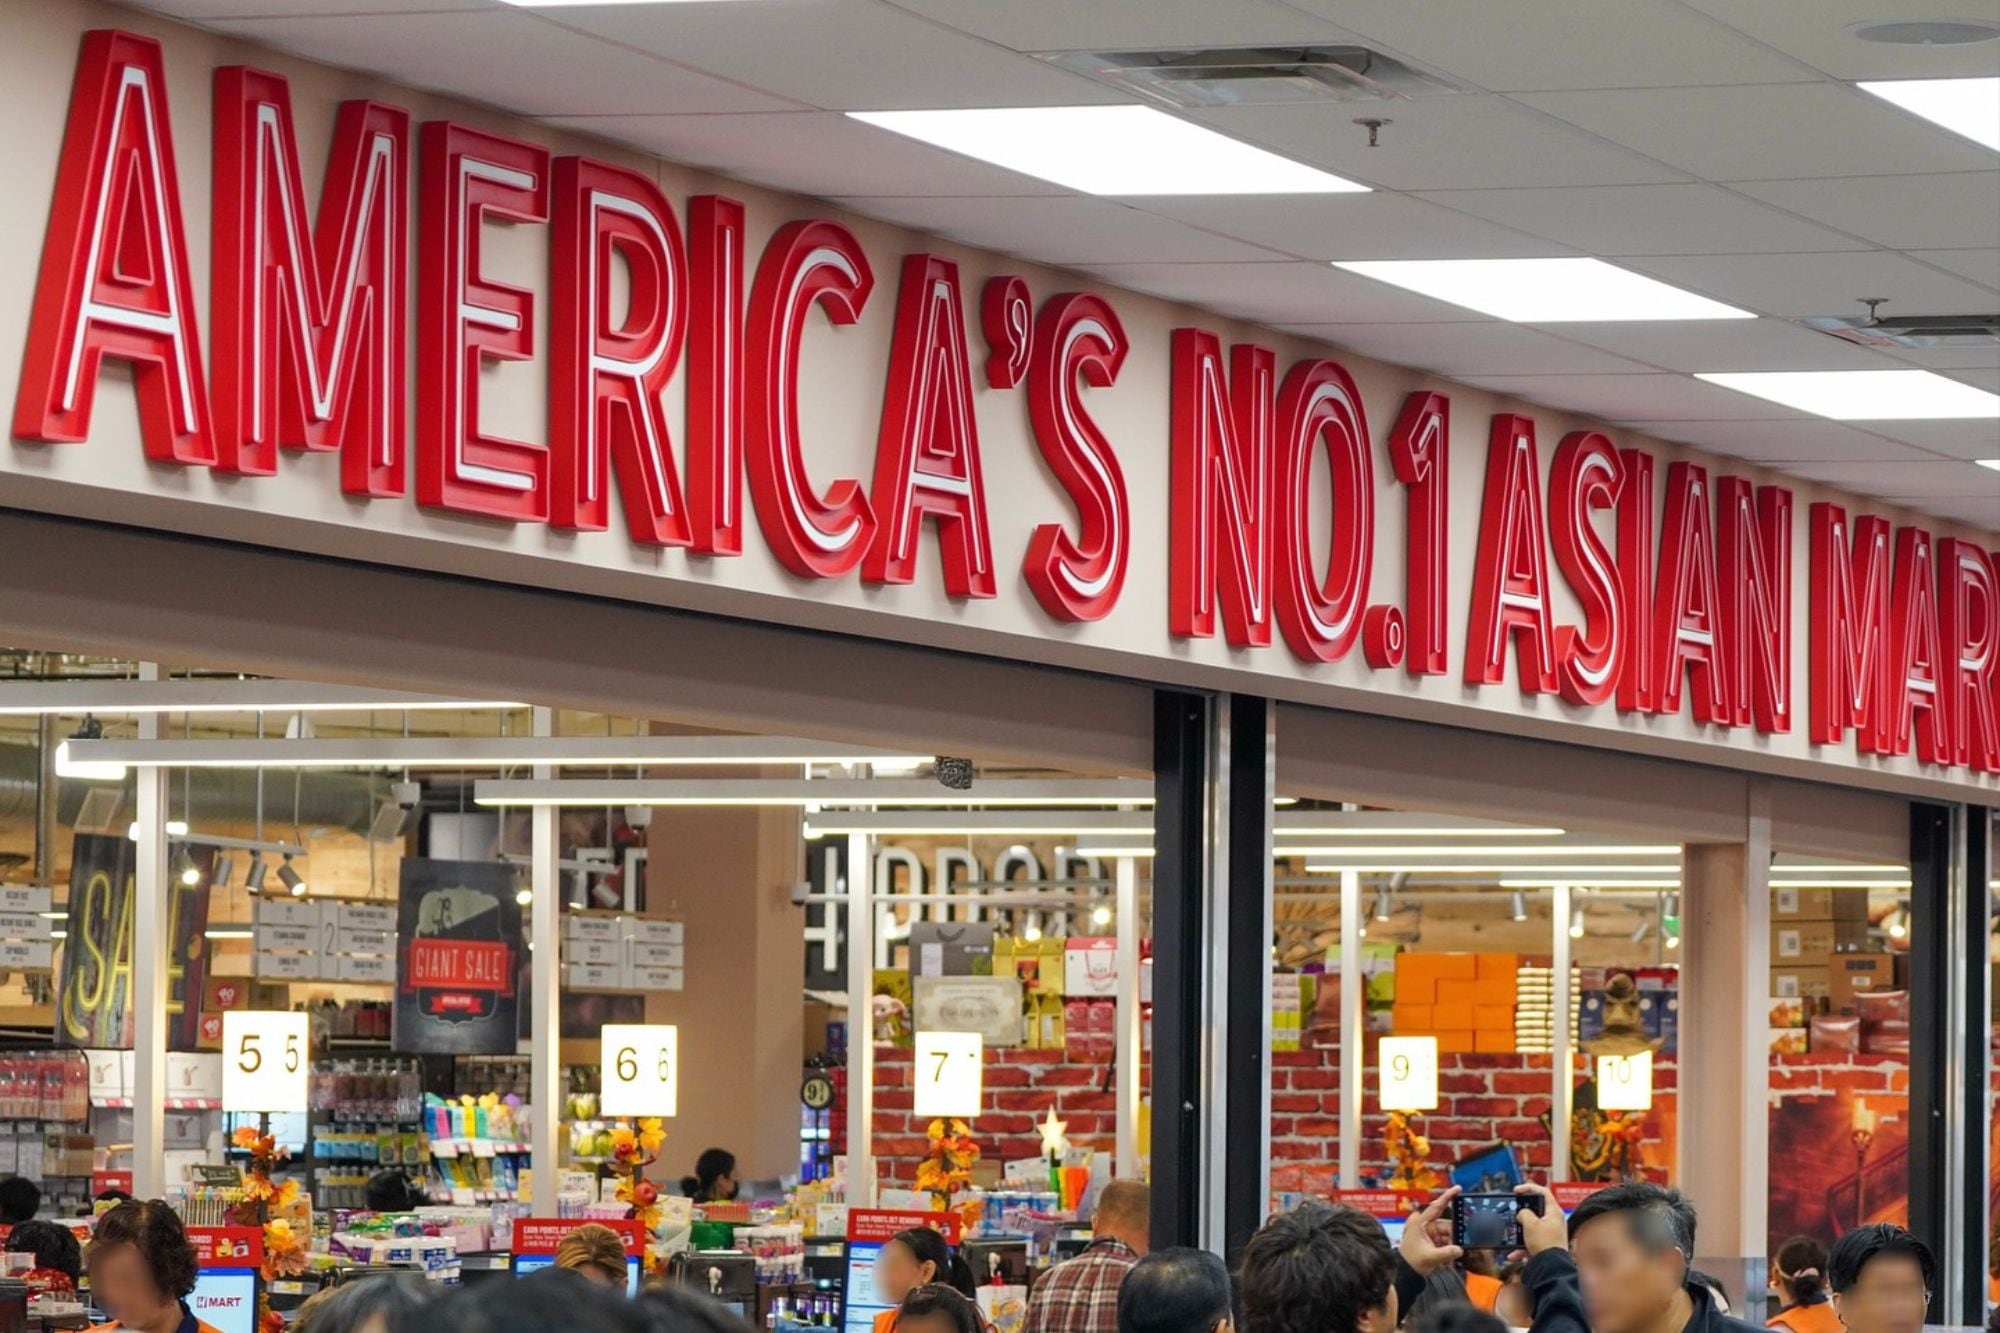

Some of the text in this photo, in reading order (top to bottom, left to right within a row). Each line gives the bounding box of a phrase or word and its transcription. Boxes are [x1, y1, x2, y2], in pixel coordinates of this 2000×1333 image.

[13, 29, 2000, 773] AMERICA'S NO.1 ASIAN MAR
[78, 869, 198, 1013] SAE
[324, 922, 335, 956] 2
[415, 947, 458, 978] GIANT
[465, 949, 500, 981] SALE
[239, 1034, 262, 1073] 5
[285, 1034, 299, 1073] 5
[617, 1046, 638, 1082] 6
[930, 1051, 949, 1082] 7
[1392, 1054, 1409, 1081] 9
[1606, 1056, 1632, 1084] 10
[208, 1297, 242, 1308] MART
